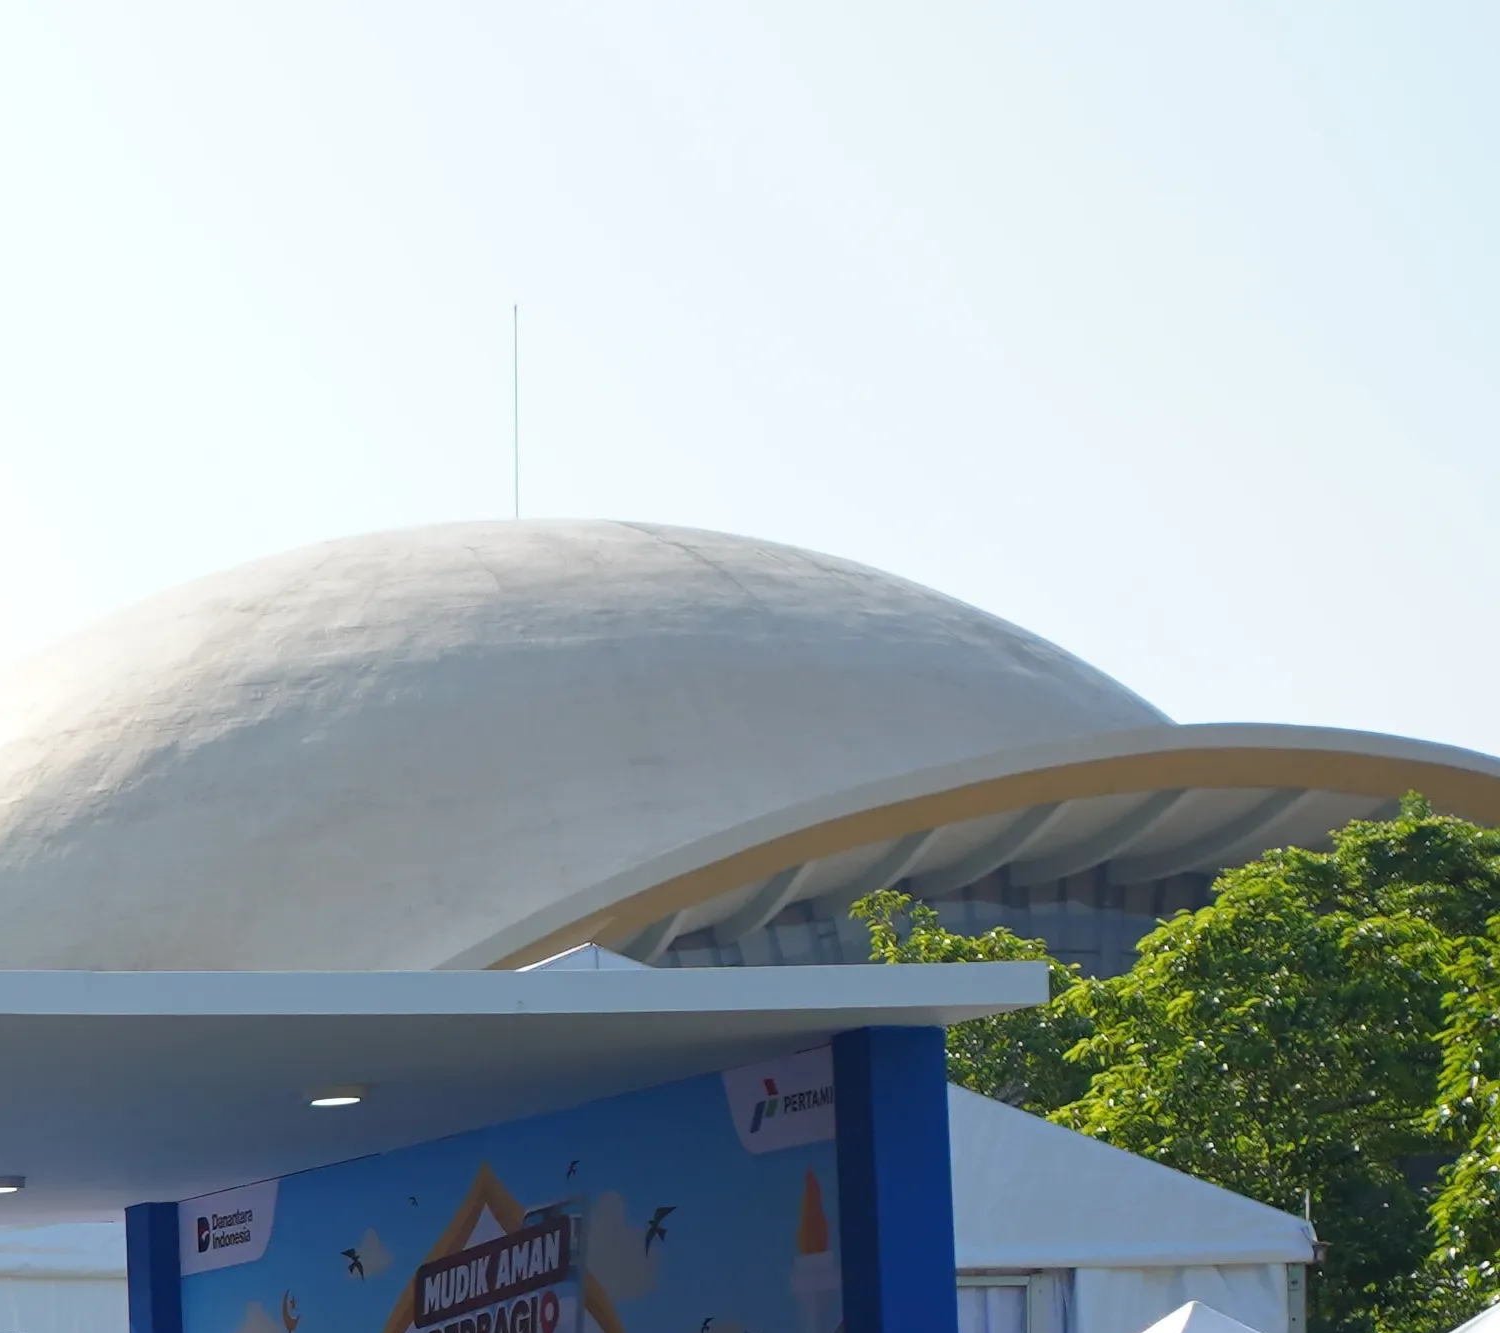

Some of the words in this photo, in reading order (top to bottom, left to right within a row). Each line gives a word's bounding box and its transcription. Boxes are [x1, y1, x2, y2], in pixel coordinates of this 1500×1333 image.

[212, 1209, 253, 1230] Danantara
[212, 1226, 251, 1249] Indonesia
[423, 1254, 490, 1316] MUDIK
[497, 1230, 560, 1287] AMAN
